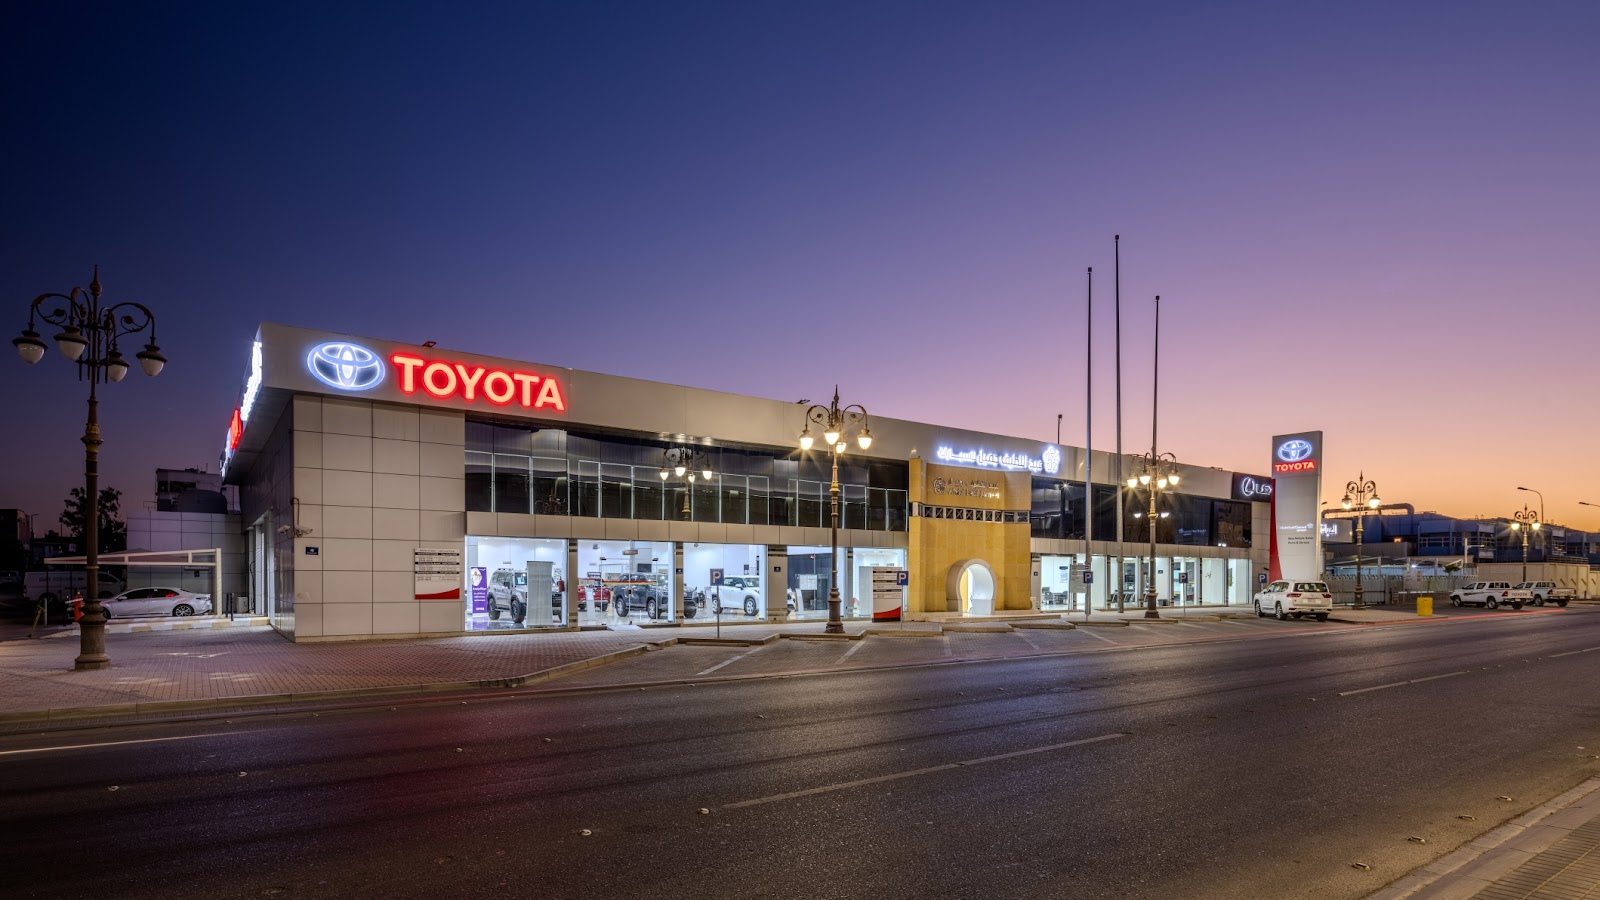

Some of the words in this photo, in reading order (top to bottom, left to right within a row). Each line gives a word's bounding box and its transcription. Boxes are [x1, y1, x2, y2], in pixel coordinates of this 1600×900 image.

[392, 355, 565, 411] TOYOTA
[1275, 461, 1314, 472] TOYOTA
[712, 571, 721, 584] P
[898, 573, 907, 584] P
[1084, 573, 1092, 582] P
[1180, 574, 1186, 583] P
[1259, 574, 1266, 582] P
